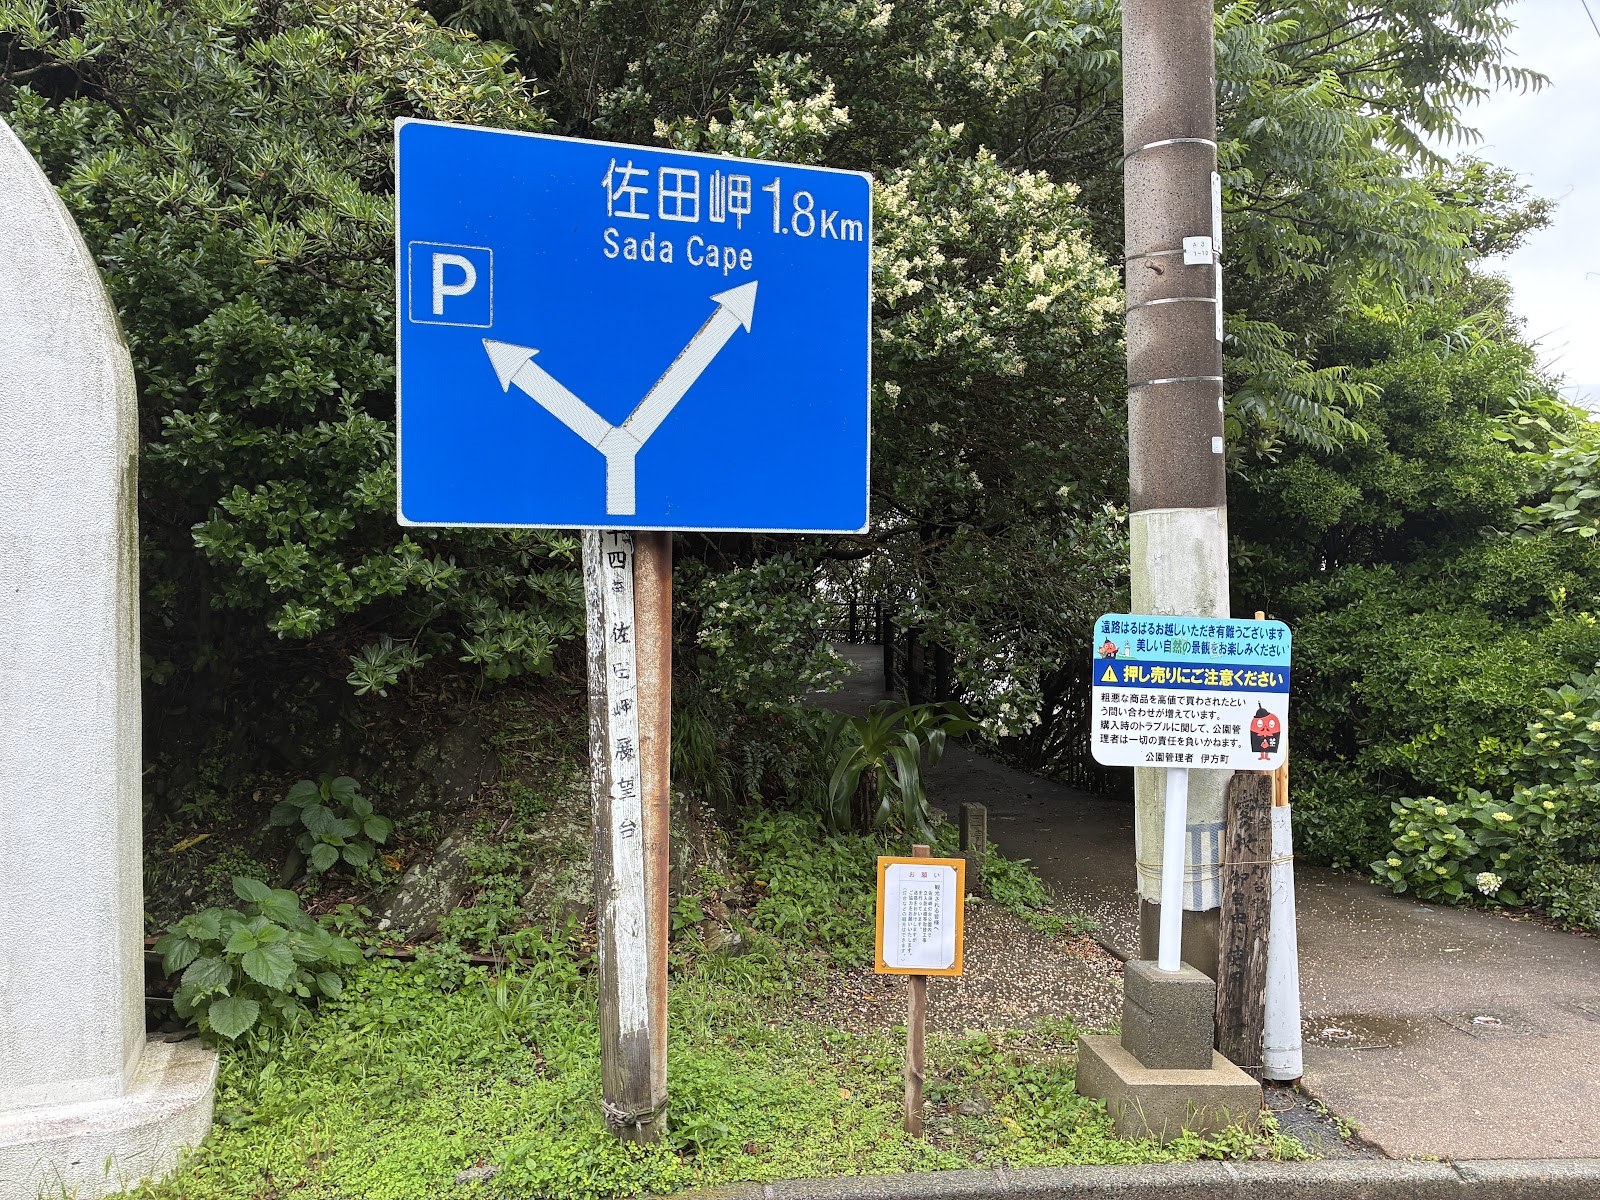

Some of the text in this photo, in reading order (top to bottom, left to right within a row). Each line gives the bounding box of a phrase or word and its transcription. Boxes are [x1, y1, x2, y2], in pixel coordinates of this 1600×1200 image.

[601, 157, 751, 230] 佐田岬
[603, 227, 753, 276] Sada Cape
[432, 252, 477, 315] P
[1101, 620, 1285, 639] 遠路はるばるお越しいただき有難うございます
[1136, 638, 1285, 657] 美しい自然の景観をお楽しみください
[1123, 665, 1284, 687] 押し売りにご注意ください
[1101, 692, 1246, 707] 粗悪な商品を高値で買わされたとい
[1101, 706, 1220, 720] う問い合わせが増えています。
[1101, 720, 1241, 735] 購入時のトラブルに関して、公園管
[1100, 734, 1242, 749] 理者は一切の責任を負いかねます。
[1145, 752, 1229, 764] 公園管理者 伊方町
